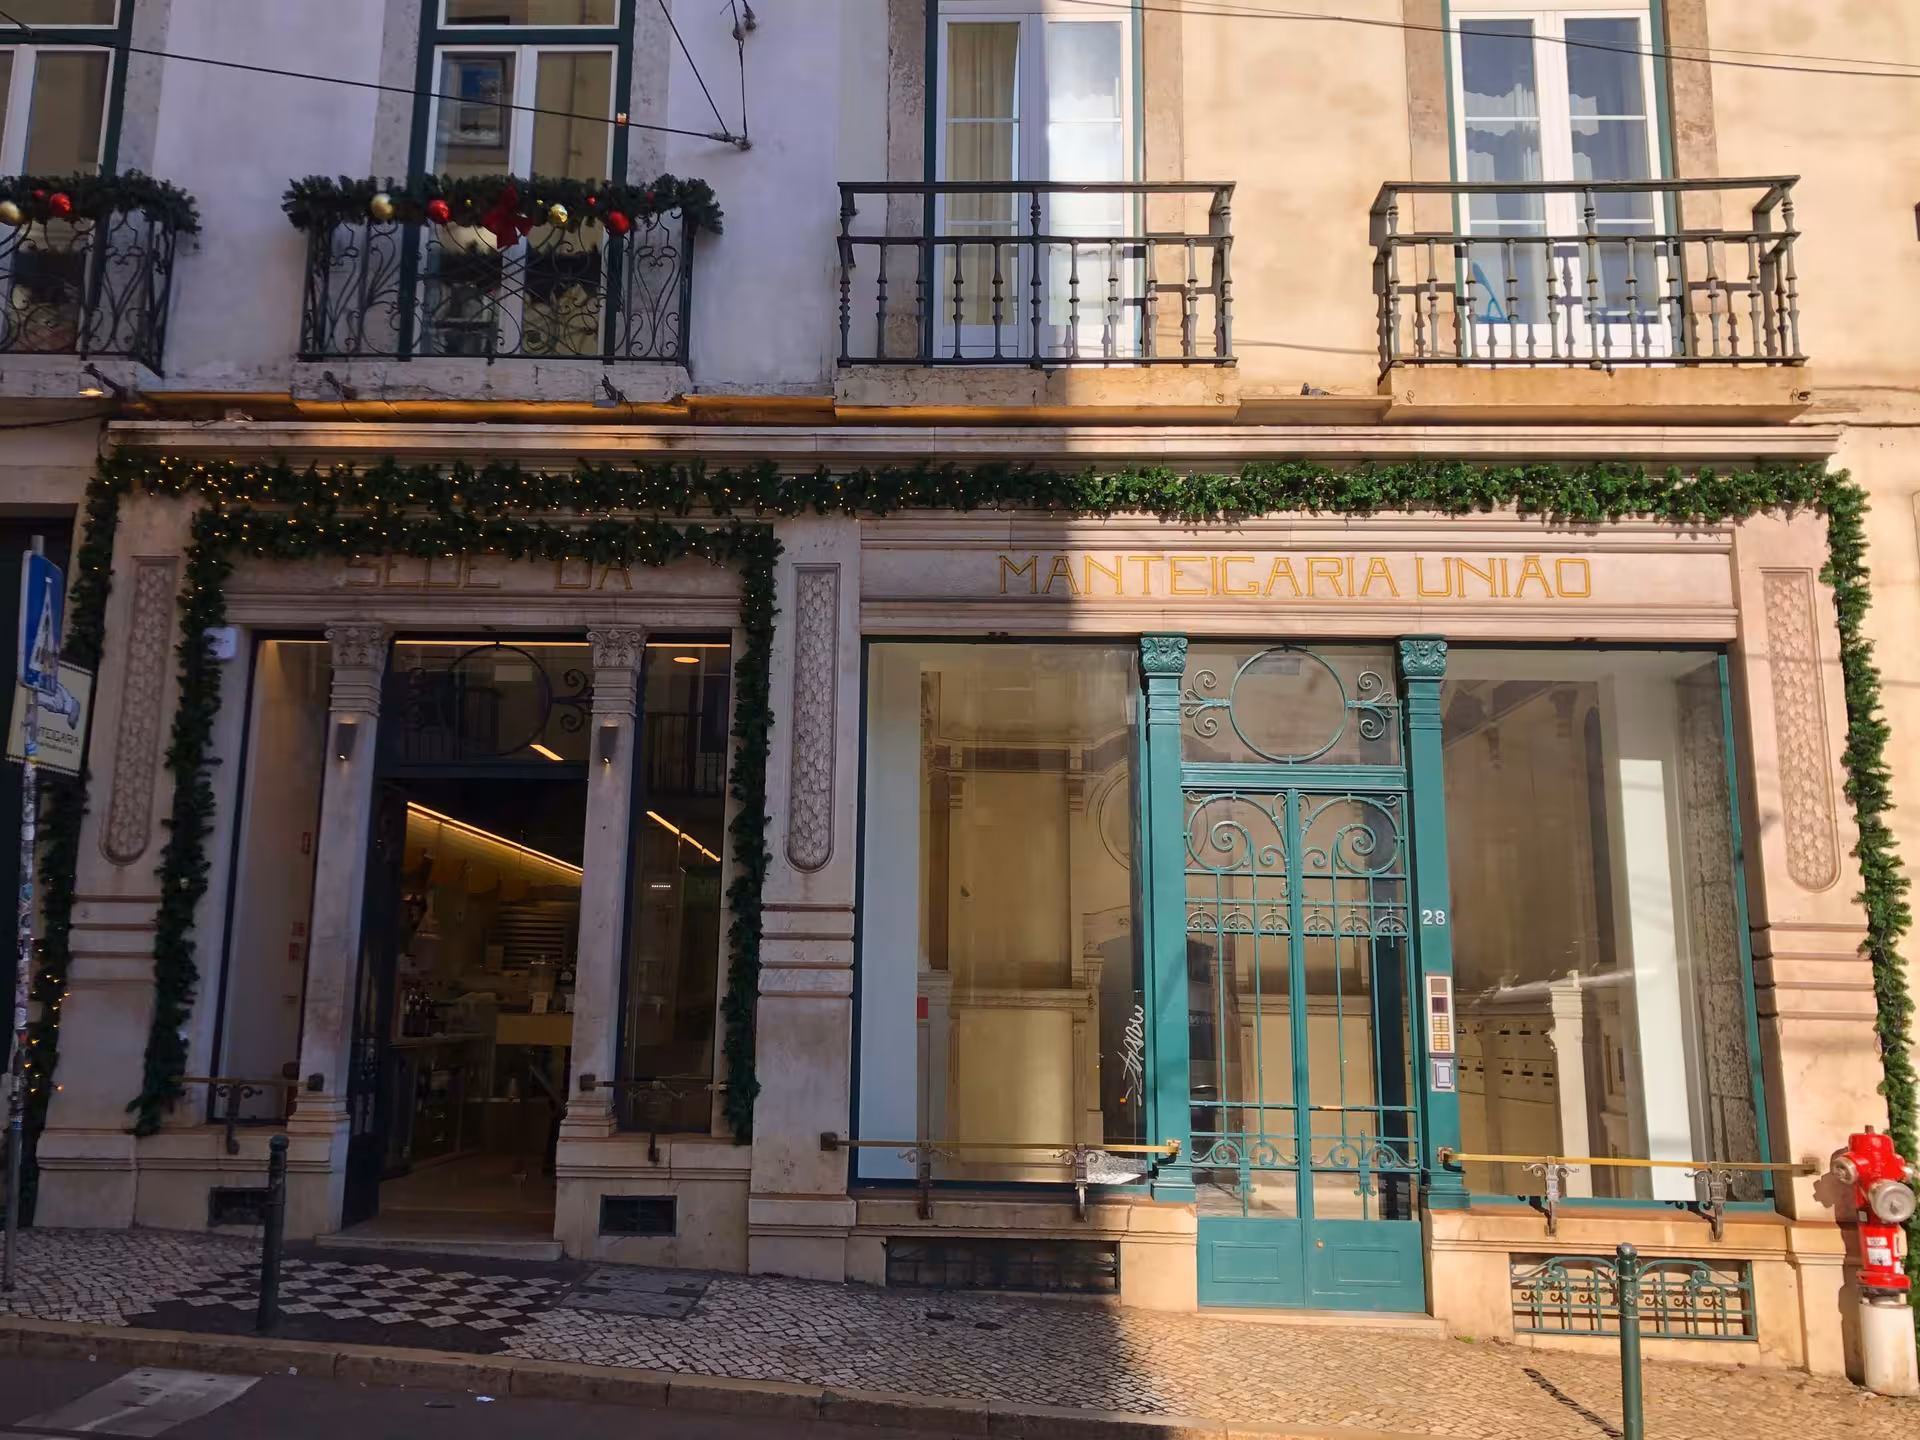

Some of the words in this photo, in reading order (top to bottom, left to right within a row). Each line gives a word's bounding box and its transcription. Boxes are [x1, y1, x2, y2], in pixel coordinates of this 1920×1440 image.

[999, 555, 1399, 598] MANTEIGARIA
[1416, 555, 1592, 598] UNIÃO
[1421, 909, 1446, 926] 28
